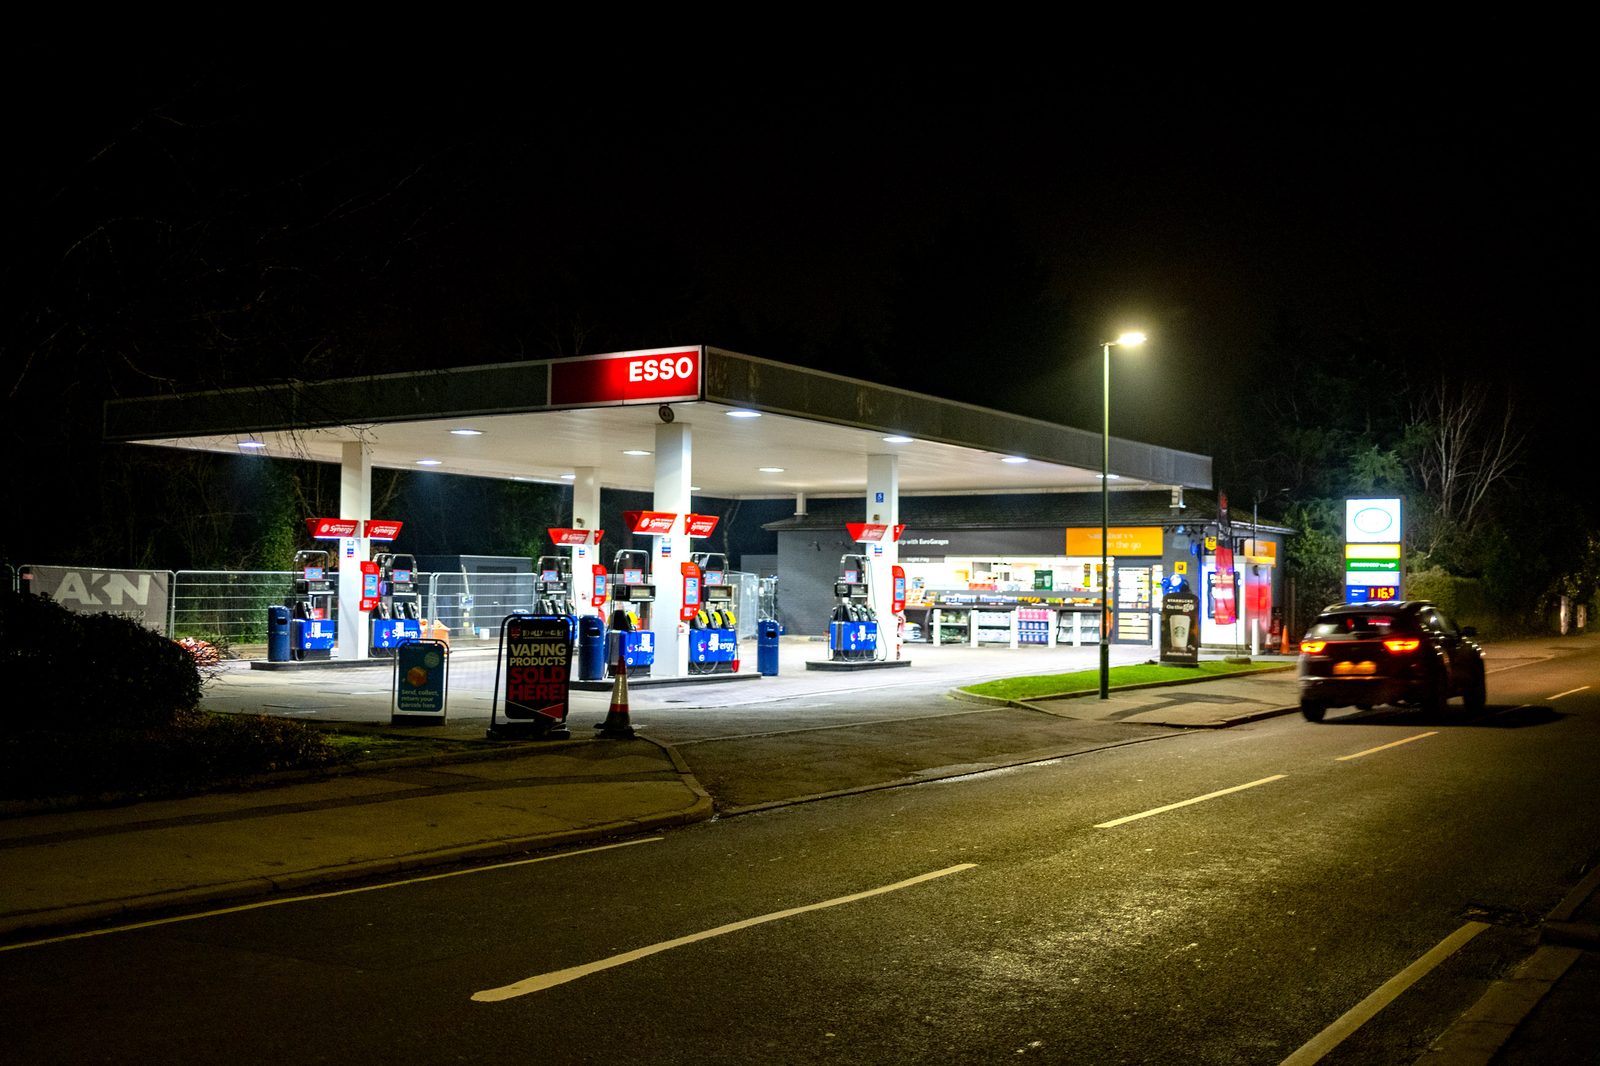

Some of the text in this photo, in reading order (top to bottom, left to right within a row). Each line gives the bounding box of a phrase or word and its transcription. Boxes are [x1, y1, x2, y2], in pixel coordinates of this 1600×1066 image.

[629, 356, 694, 382] ESSO
[329, 525, 354, 534] Synergy
[373, 526, 396, 535] Synergy
[649, 519, 672, 531] Synergy
[510, 643, 567, 657] VAPING
[509, 656, 567, 667] PRODUCTS
[511, 667, 566, 684] SOLD
[508, 683, 565, 700] HERE!
